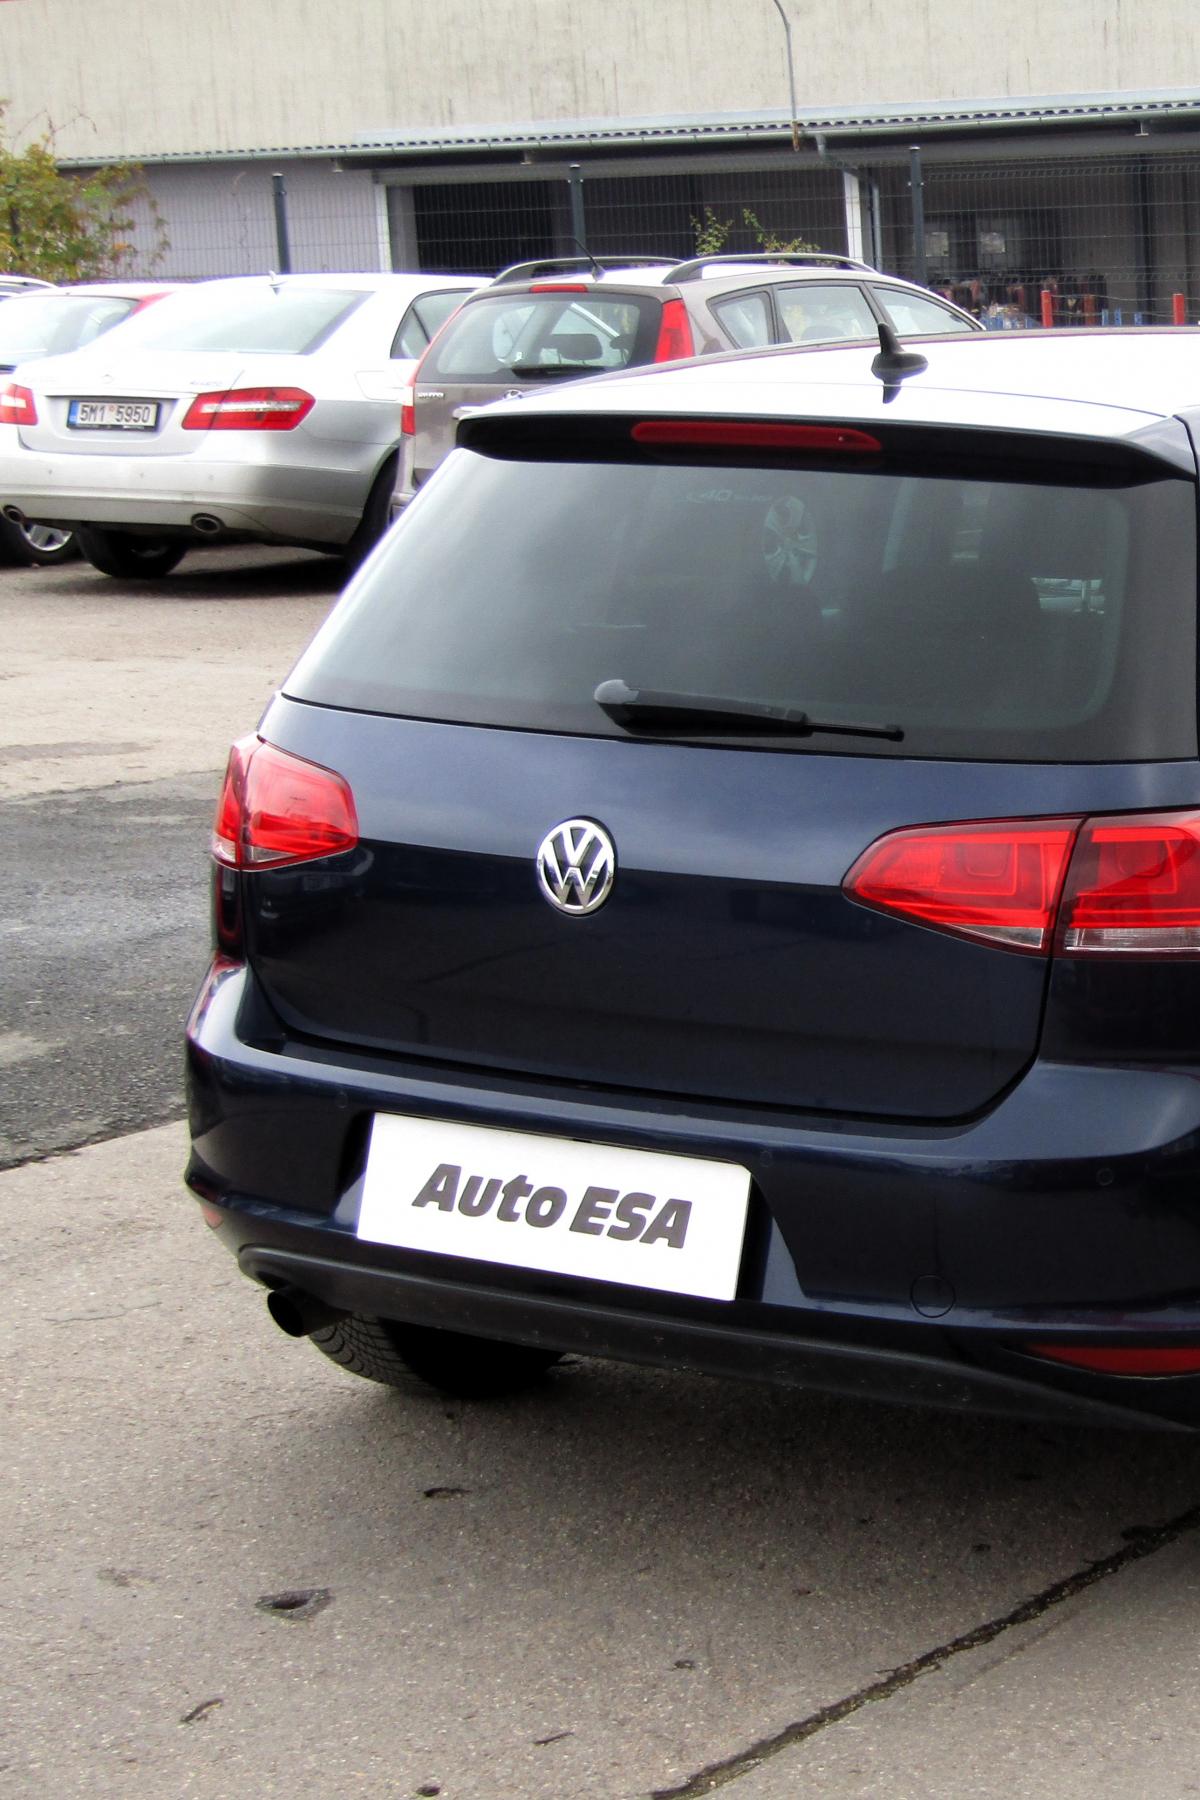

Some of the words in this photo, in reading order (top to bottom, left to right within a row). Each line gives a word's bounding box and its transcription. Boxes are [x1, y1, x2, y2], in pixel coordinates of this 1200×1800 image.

[80, 404, 105, 422] 5M1
[115, 405, 151, 423] 5950
[537, 819, 614, 914] VW
[411, 1163, 568, 1229] Auto
[568, 1186, 693, 1249] ESA
